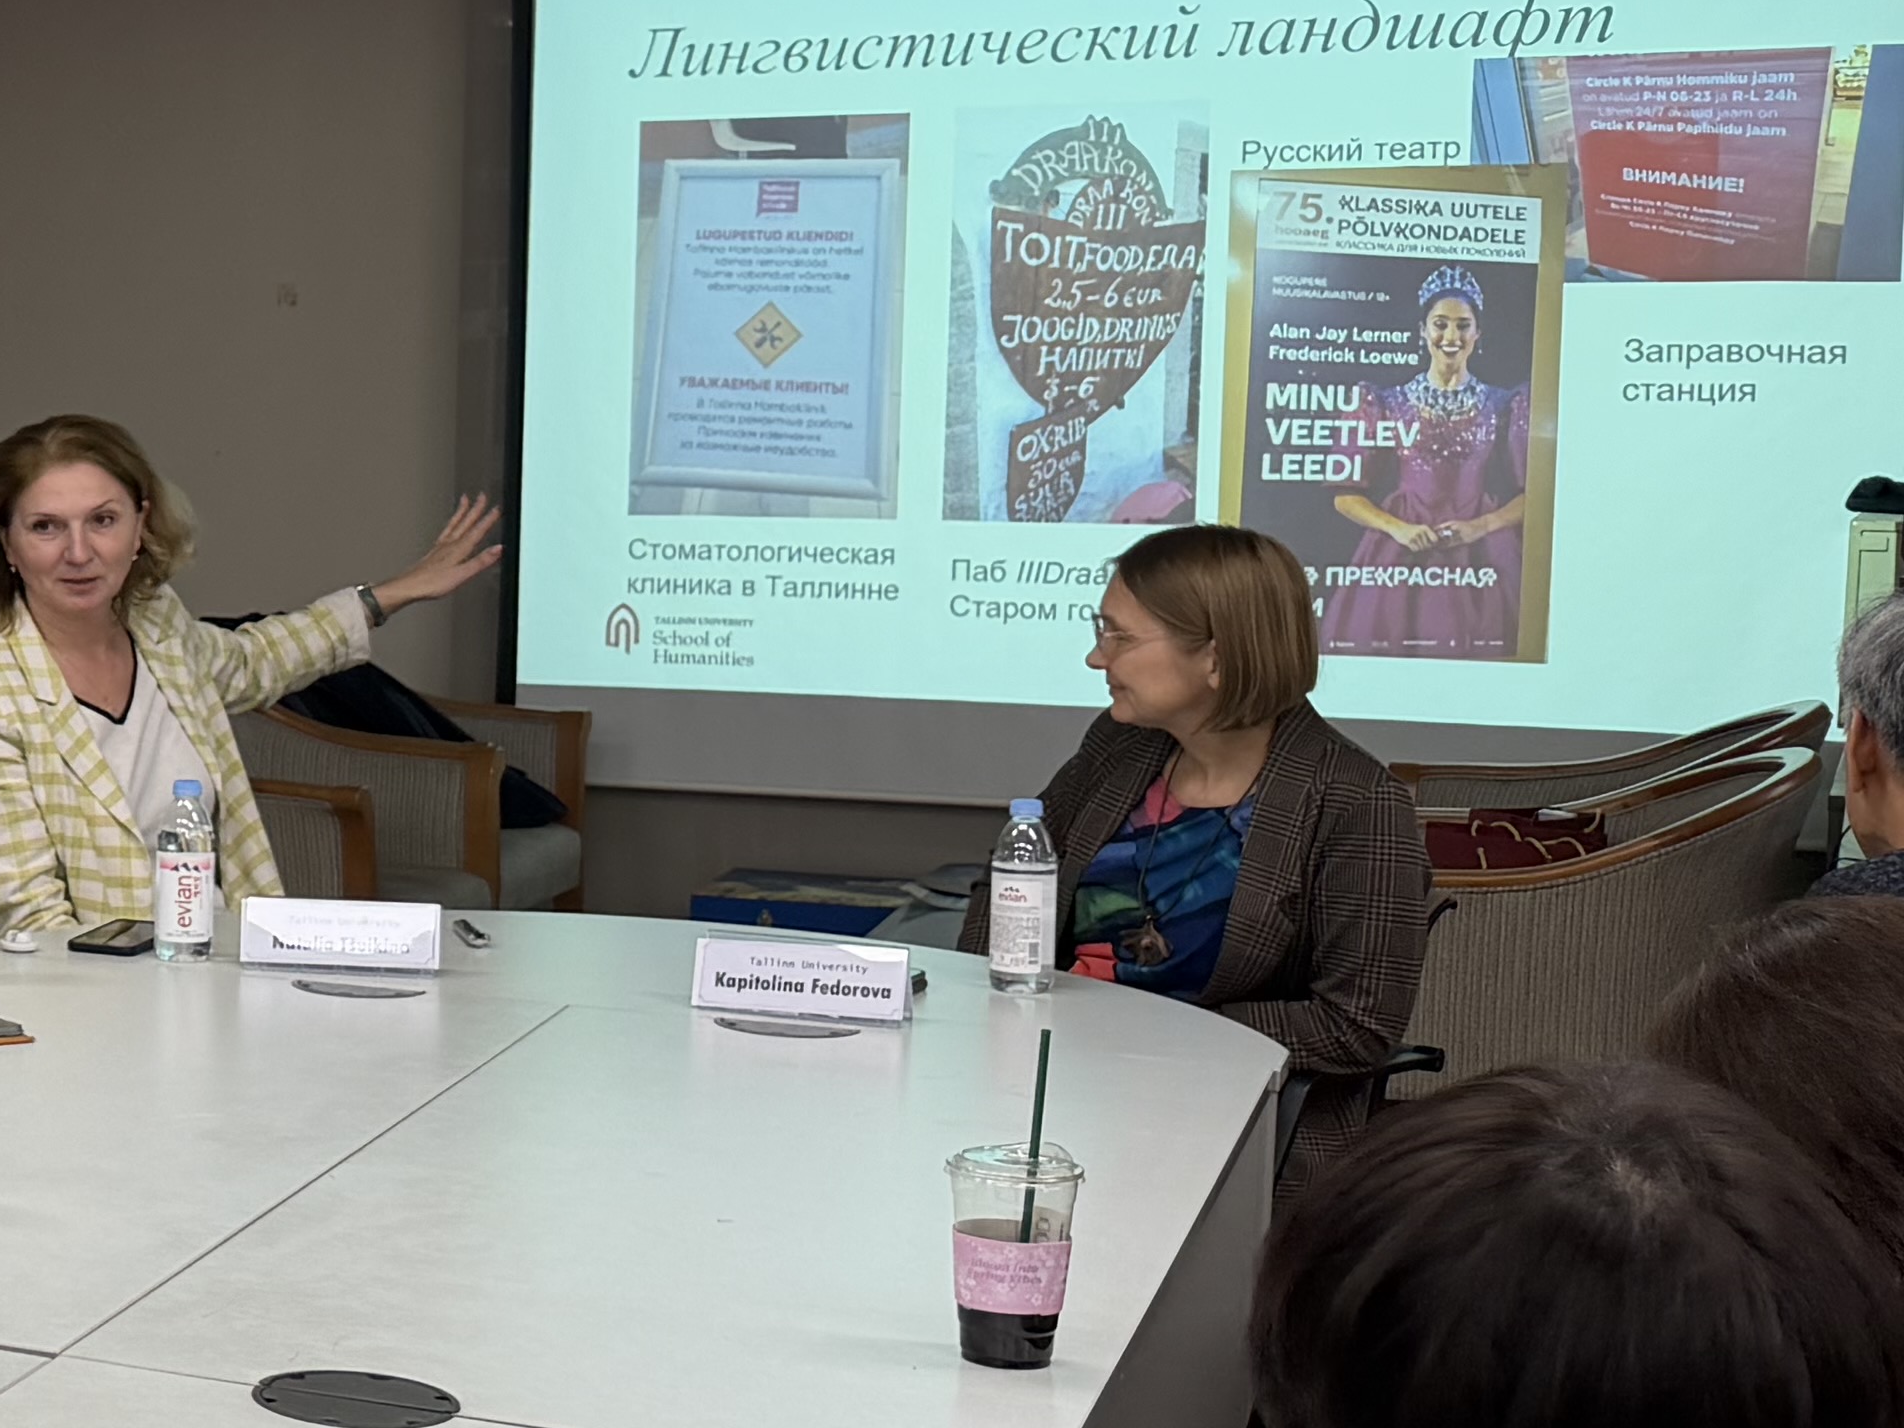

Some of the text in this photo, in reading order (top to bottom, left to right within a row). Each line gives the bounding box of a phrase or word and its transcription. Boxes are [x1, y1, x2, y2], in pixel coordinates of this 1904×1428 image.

[627, 5, 1200, 82] Лингвистический
[1751, 70, 1795, 86] jaam
[1643, 90, 1667, 103] P-N
[1242, 138, 1462, 170] Русский театр
[1623, 167, 1745, 194] ВНИМАНИЕ!
[1092, 202, 1127, 231] III
[1338, 194, 1527, 222] KLASSIKA UUTELE
[1337, 215, 1526, 245] PÕLVKONDADELE
[1269, 323, 1411, 344] Alan Jay Lerner
[1268, 345, 1419, 365] Frederick Loewe
[1624, 338, 1849, 371] Заправочная
[678, 376, 850, 396] УВАЖАЕМЫЕ КЛИЕНТЫ!
[1265, 382, 1360, 412] MINU
[1622, 377, 1758, 408] станция
[1265, 418, 1421, 447] VEETLEV
[1261, 453, 1361, 481] LEEDI
[628, 537, 896, 566] Стоматологическая
[951, 558, 1007, 584] Паб
[1325, 567, 1498, 588] ПРЕКРАСНАЯ
[627, 575, 900, 601] клиника в Таллинне
[950, 594, 1057, 622] Старом
[652, 629, 732, 648] School of
[652, 649, 755, 668] Humanities
[174, 874, 193, 928] evian
[749, 955, 869, 976] Tallinn University
[714, 970, 892, 1000] Kapitolina Fedorova
